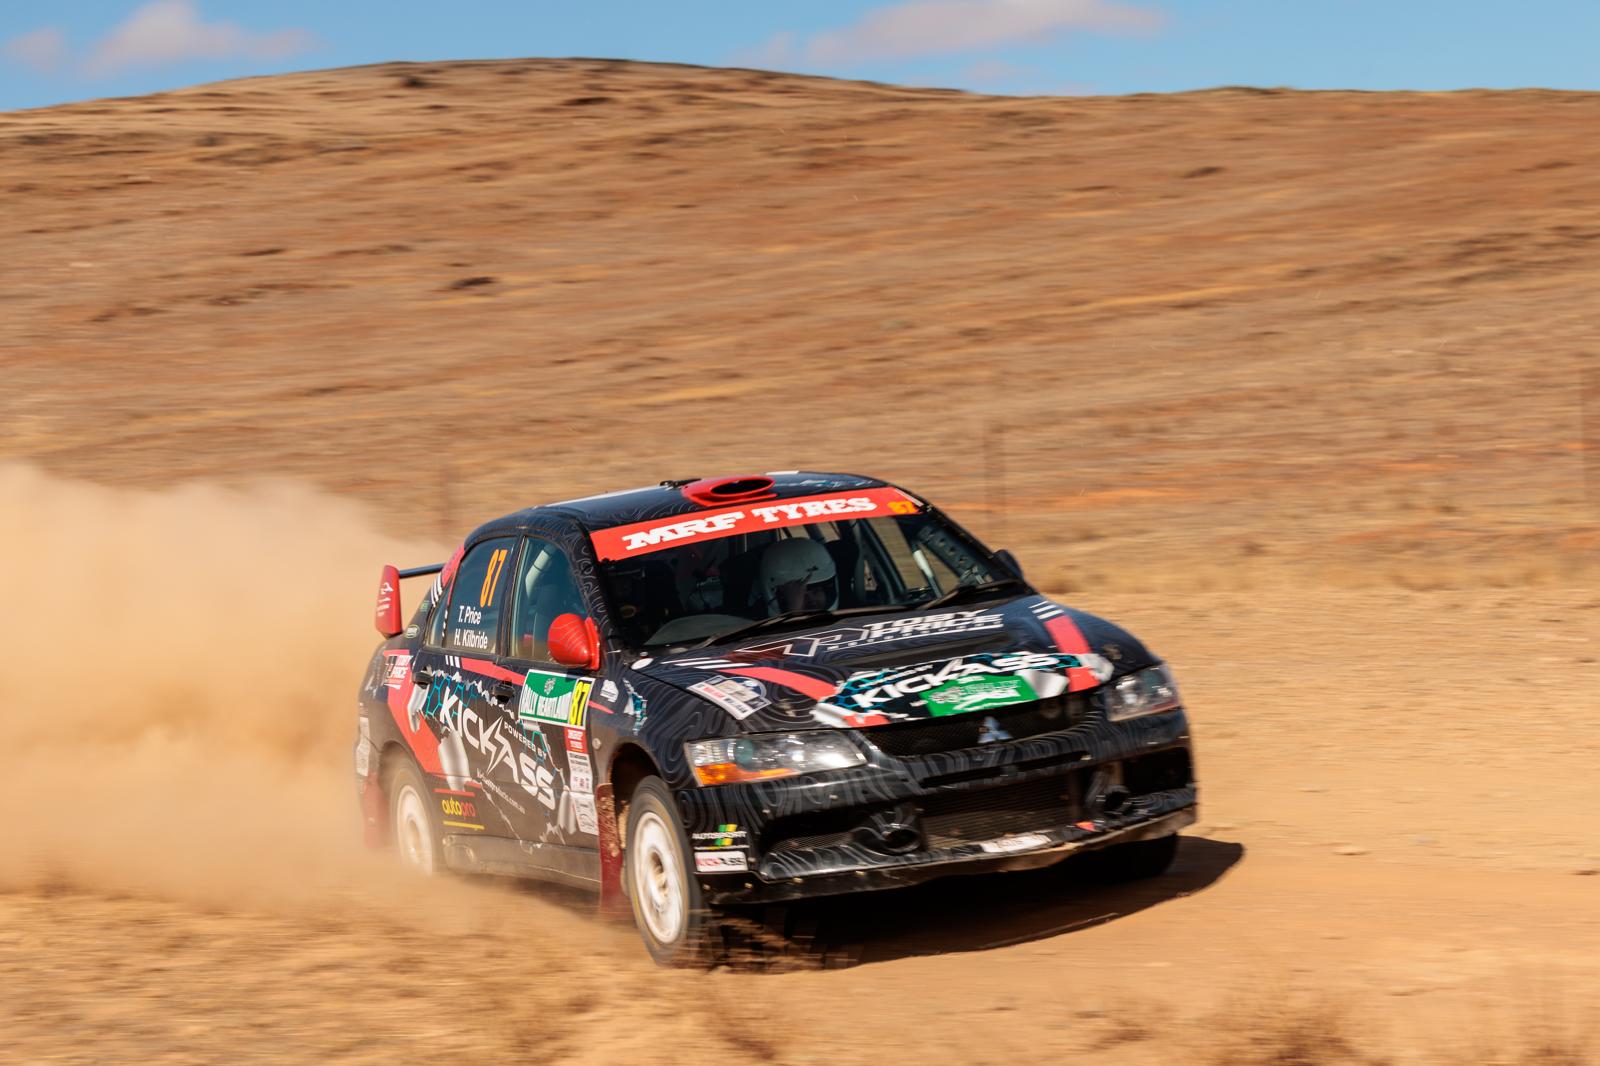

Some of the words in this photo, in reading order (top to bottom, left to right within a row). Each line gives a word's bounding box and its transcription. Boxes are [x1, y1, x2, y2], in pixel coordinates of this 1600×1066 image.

[621, 511, 746, 551] MRF
[751, 497, 878, 524] TYRES
[479, 548, 508, 608] 87
[458, 605, 465, 623] T.
[464, 606, 482, 625] Price
[863, 608, 989, 629] TOBY
[869, 613, 1004, 639] PRICE
[453, 628, 461, 646] H.
[462, 629, 488, 649] Kilbride
[851, 653, 1060, 708] KICKASS
[569, 681, 592, 726] 87
[440, 686, 556, 811] KICKASS
[503, 721, 536, 752] POWERED
[441, 797, 476, 817] autopro
